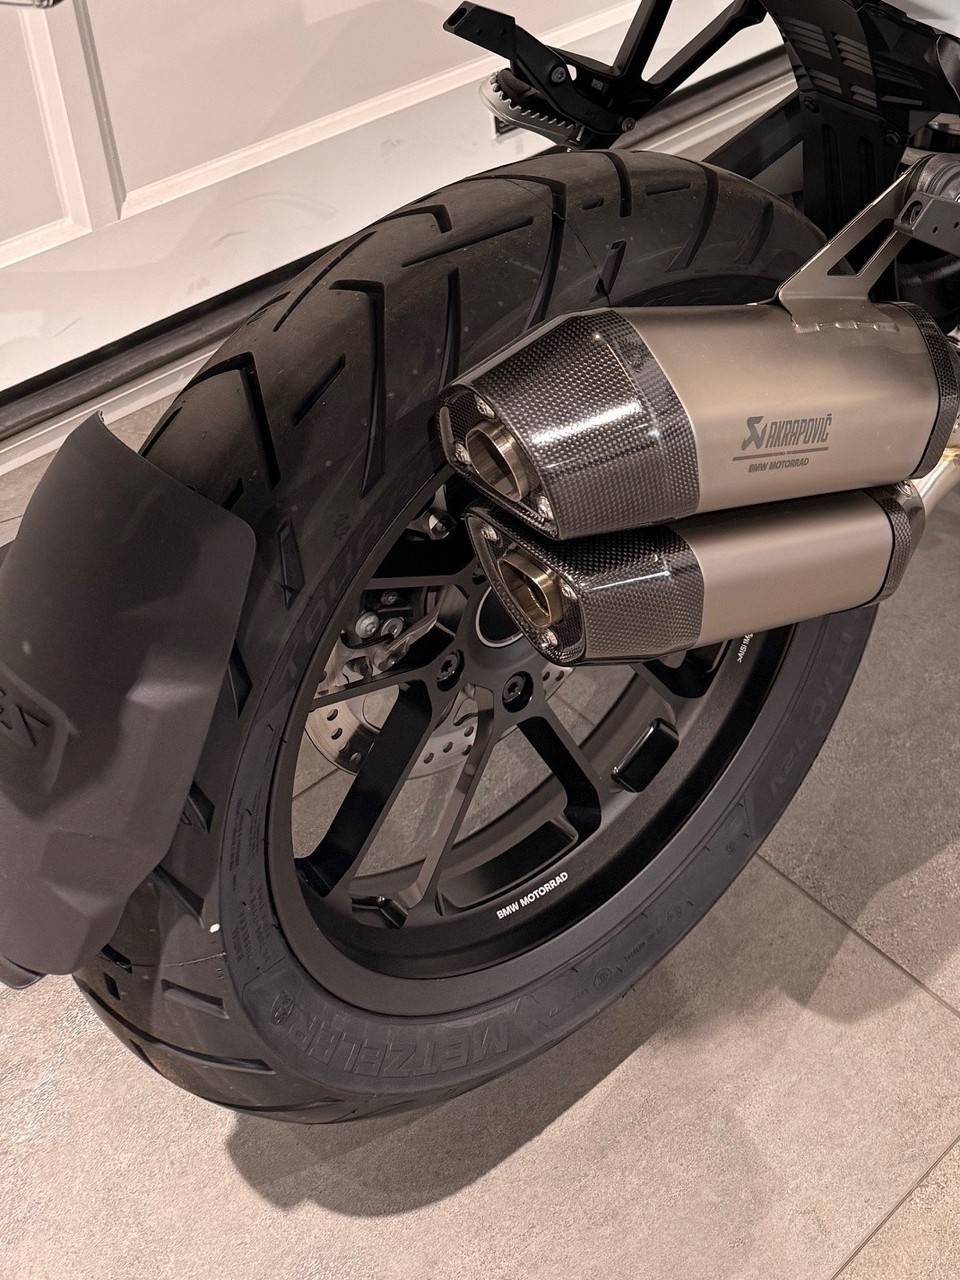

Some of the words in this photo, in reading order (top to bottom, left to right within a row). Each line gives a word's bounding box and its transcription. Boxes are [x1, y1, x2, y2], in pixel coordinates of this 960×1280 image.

[748, 461, 769, 473] BMW
[769, 457, 810, 471] MOTORRAD
[496, 901, 520, 920] BMW
[519, 871, 569, 907] MOTORRAD
